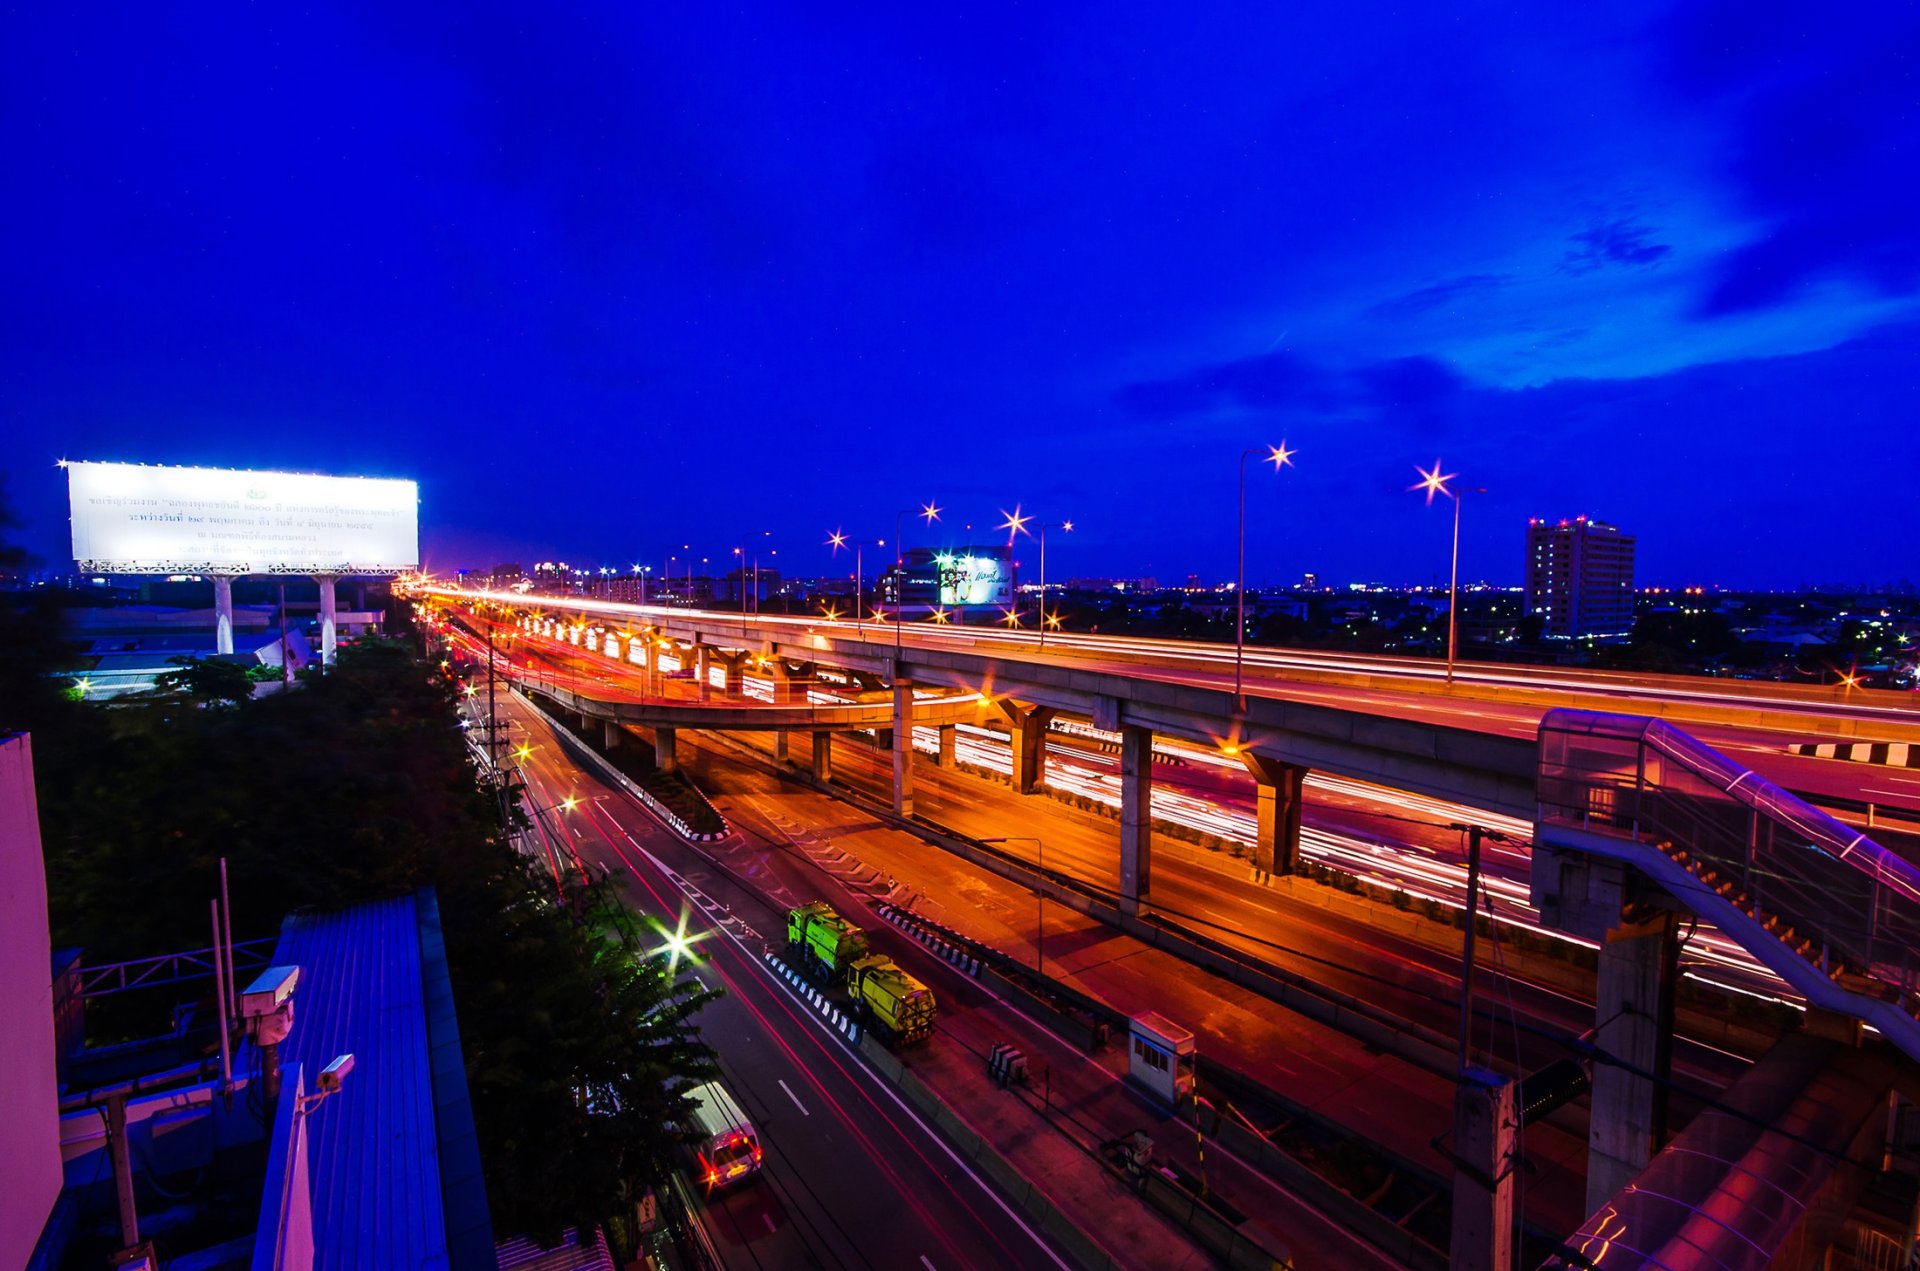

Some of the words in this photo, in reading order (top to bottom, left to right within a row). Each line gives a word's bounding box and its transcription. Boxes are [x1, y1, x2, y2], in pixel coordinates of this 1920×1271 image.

[129, 510, 183, 521] ระหว่างวันที่
